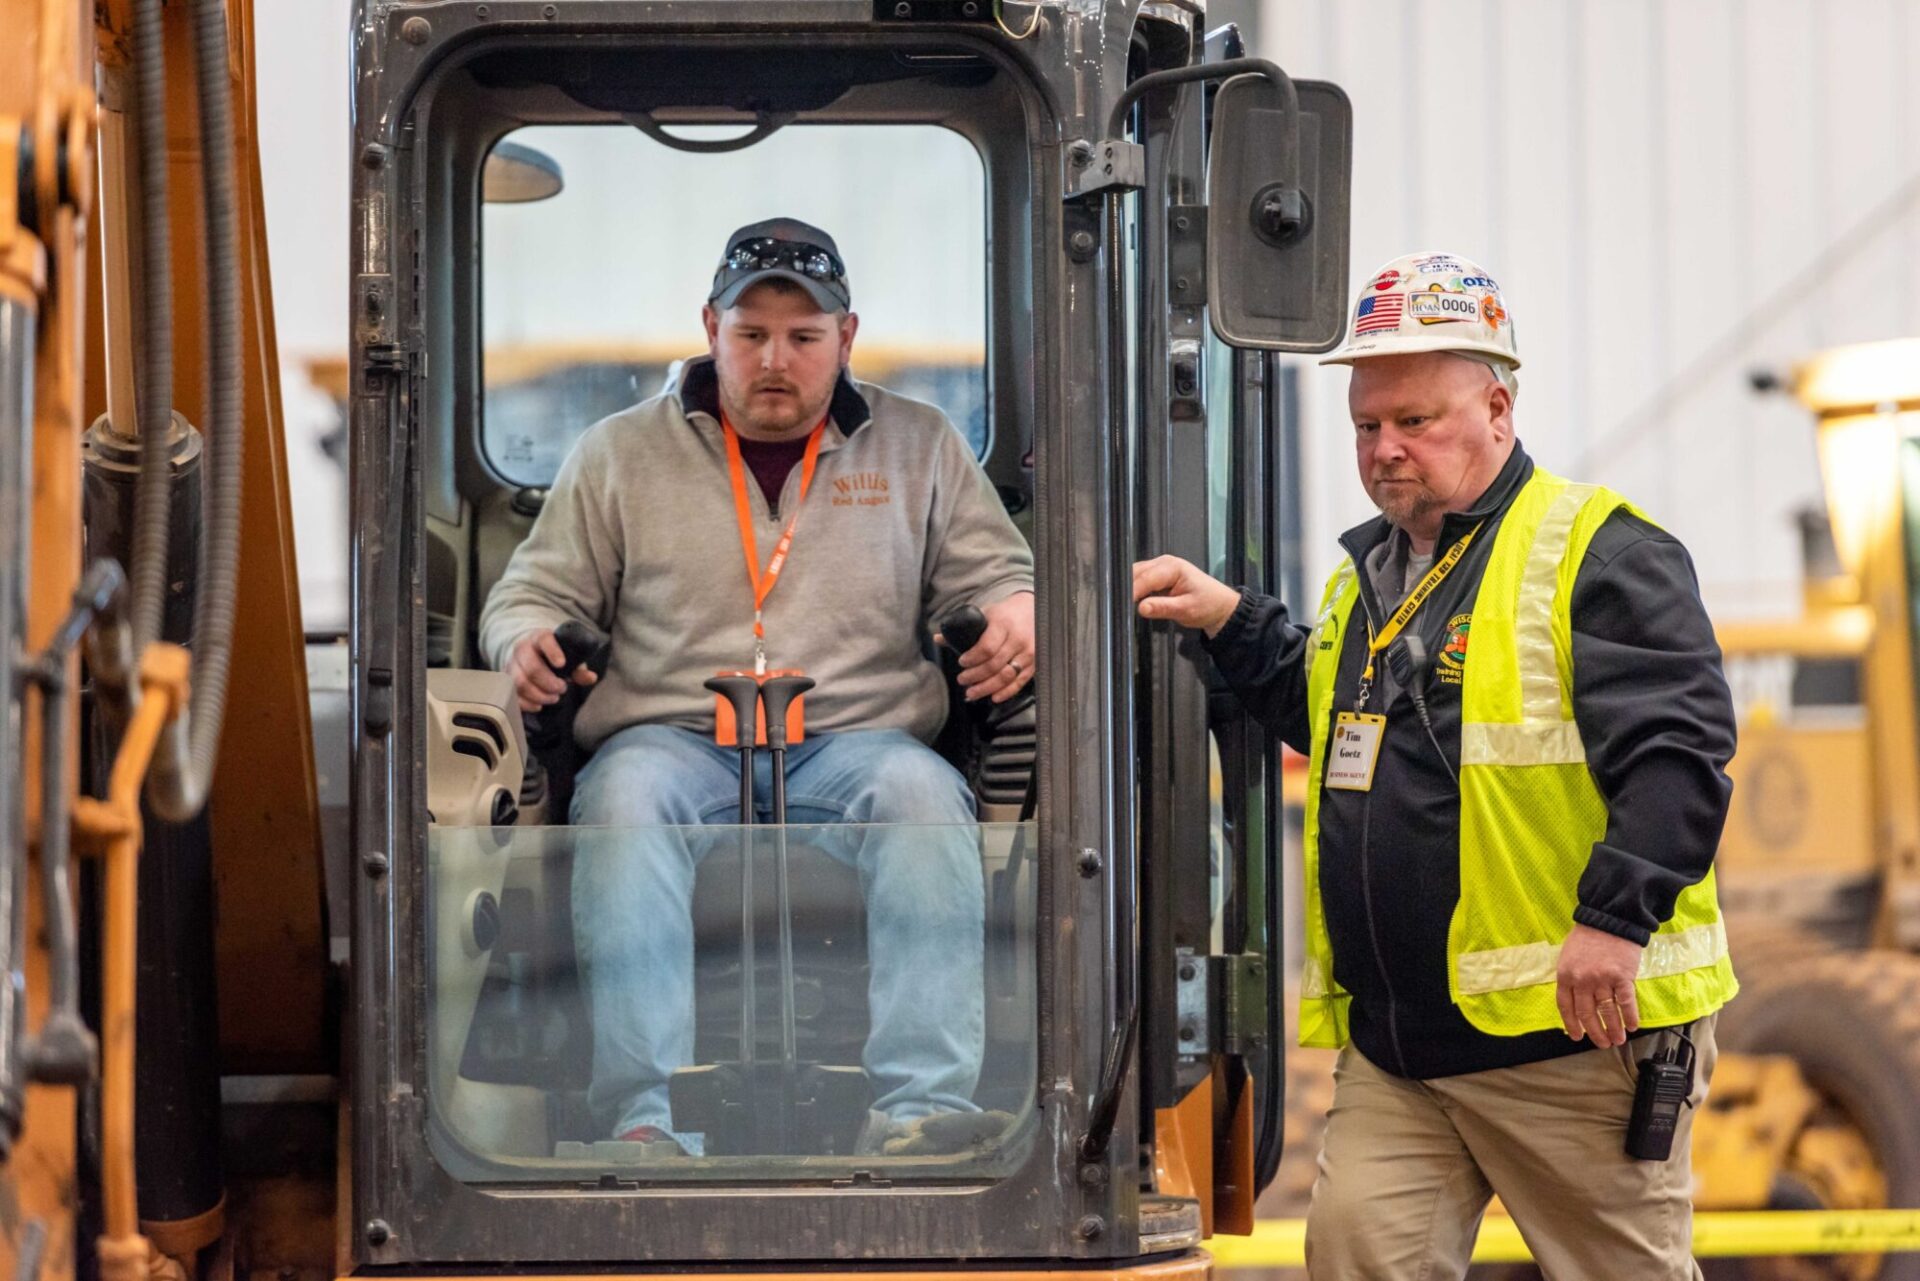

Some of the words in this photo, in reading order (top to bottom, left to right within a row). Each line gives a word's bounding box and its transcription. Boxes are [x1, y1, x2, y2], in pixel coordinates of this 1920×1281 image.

[1442, 299, 1475, 314] 0006
[833, 473, 888, 494] Willis
[1413, 573, 1440, 603] TRAINING
[1436, 667, 1462, 677] Training
[1441, 675, 1462, 684] Local
[1346, 730, 1361, 742] Tim
[1339, 747, 1361, 758] Goetz
